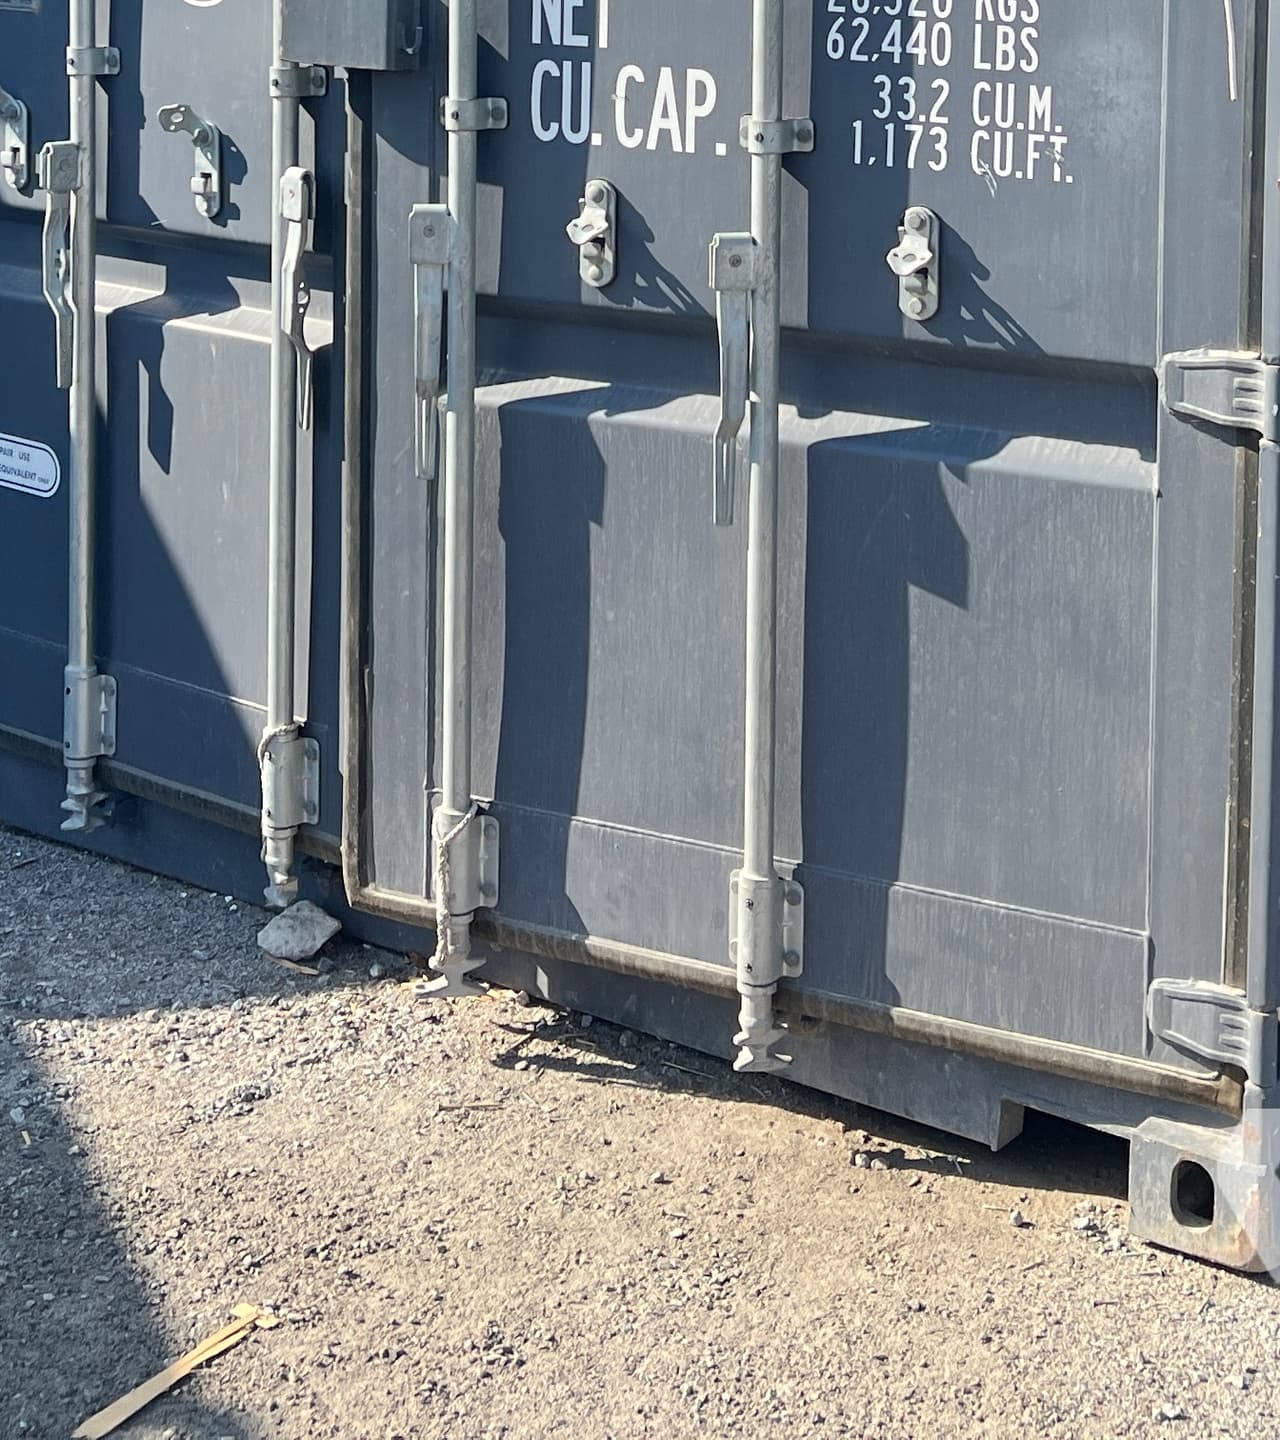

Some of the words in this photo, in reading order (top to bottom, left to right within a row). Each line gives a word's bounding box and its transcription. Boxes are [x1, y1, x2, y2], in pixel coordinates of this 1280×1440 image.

[826, 15, 952, 67] 62,440
[973, 23, 1039, 73] LBS
[872, 74, 950, 124] 33.2
[972, 80, 1063, 133] CU.M.
[852, 119, 949, 172] 1,173
[970, 129, 1074, 183] CU.FT.
[18, 451, 31, 463] USE
